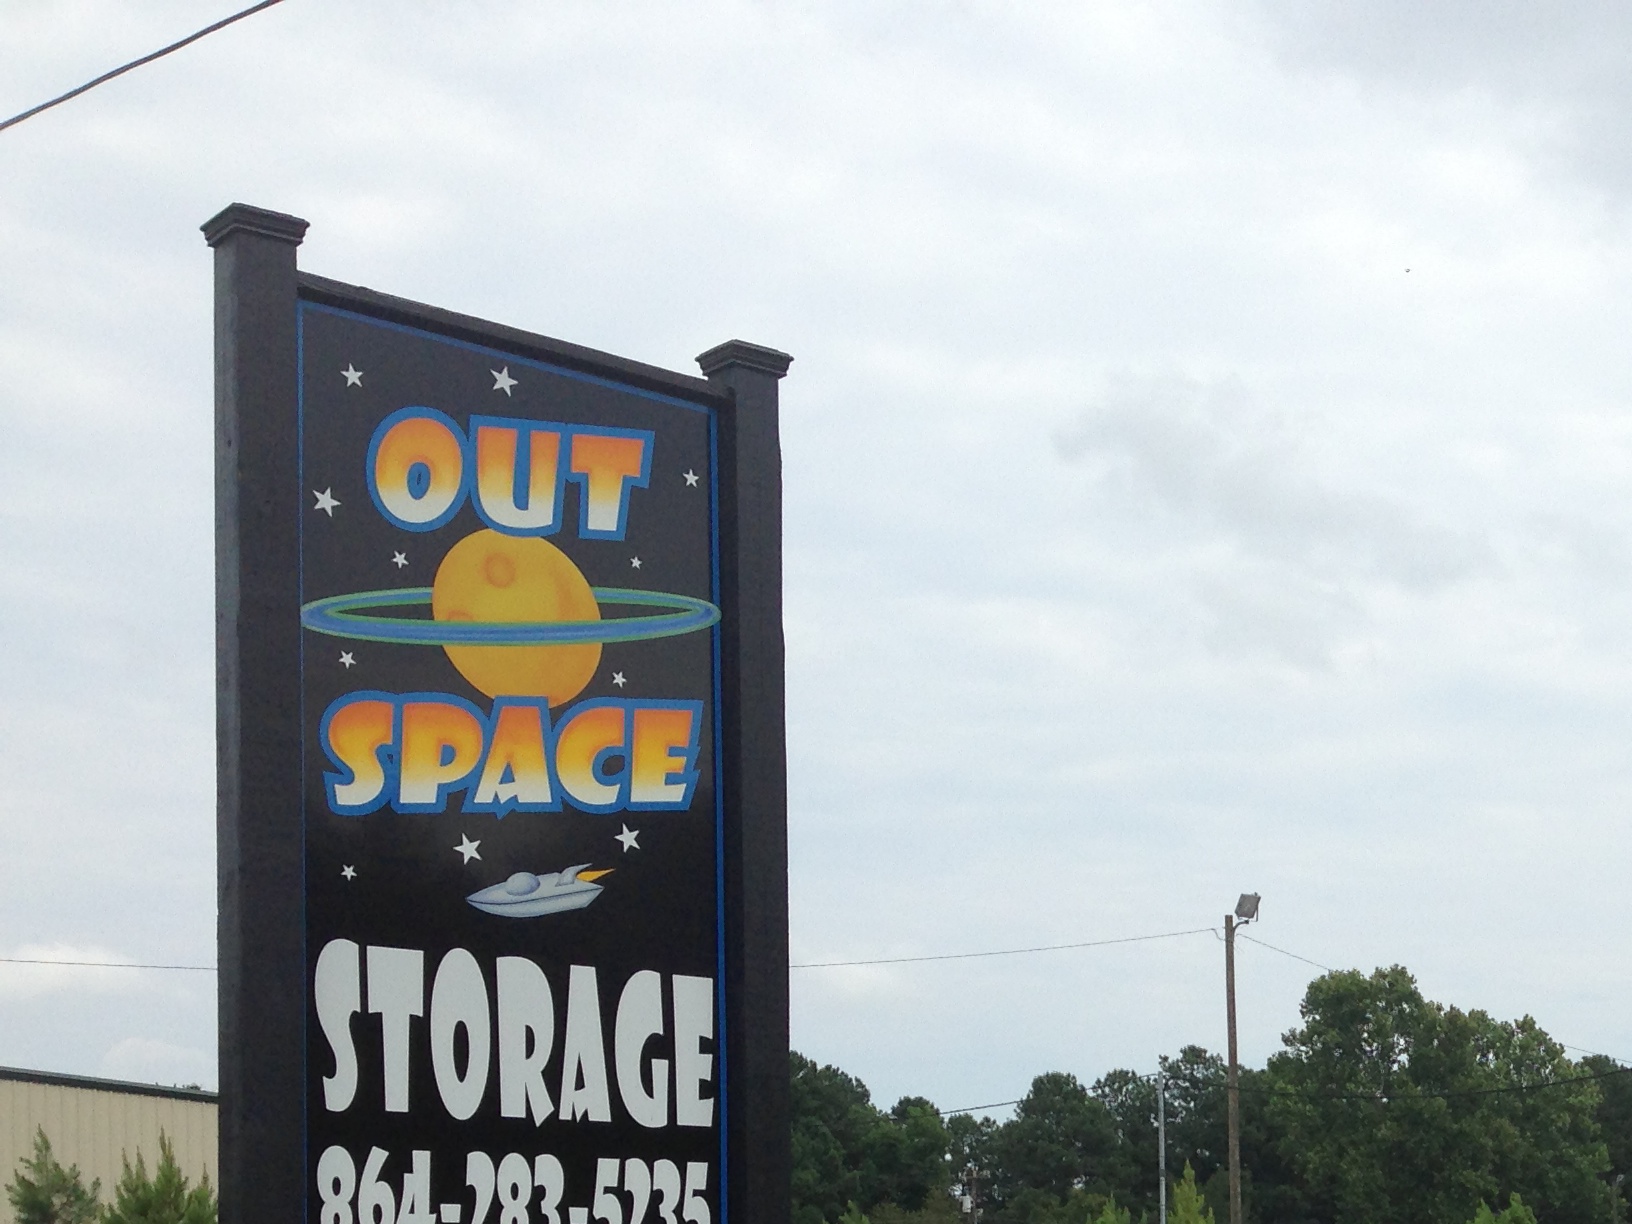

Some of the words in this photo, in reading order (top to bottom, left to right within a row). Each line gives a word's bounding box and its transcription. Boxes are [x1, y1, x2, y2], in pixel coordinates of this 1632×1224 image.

[366, 406, 656, 542] OUT
[320, 690, 705, 819] SPACE
[313, 937, 715, 1129] STORAGE
